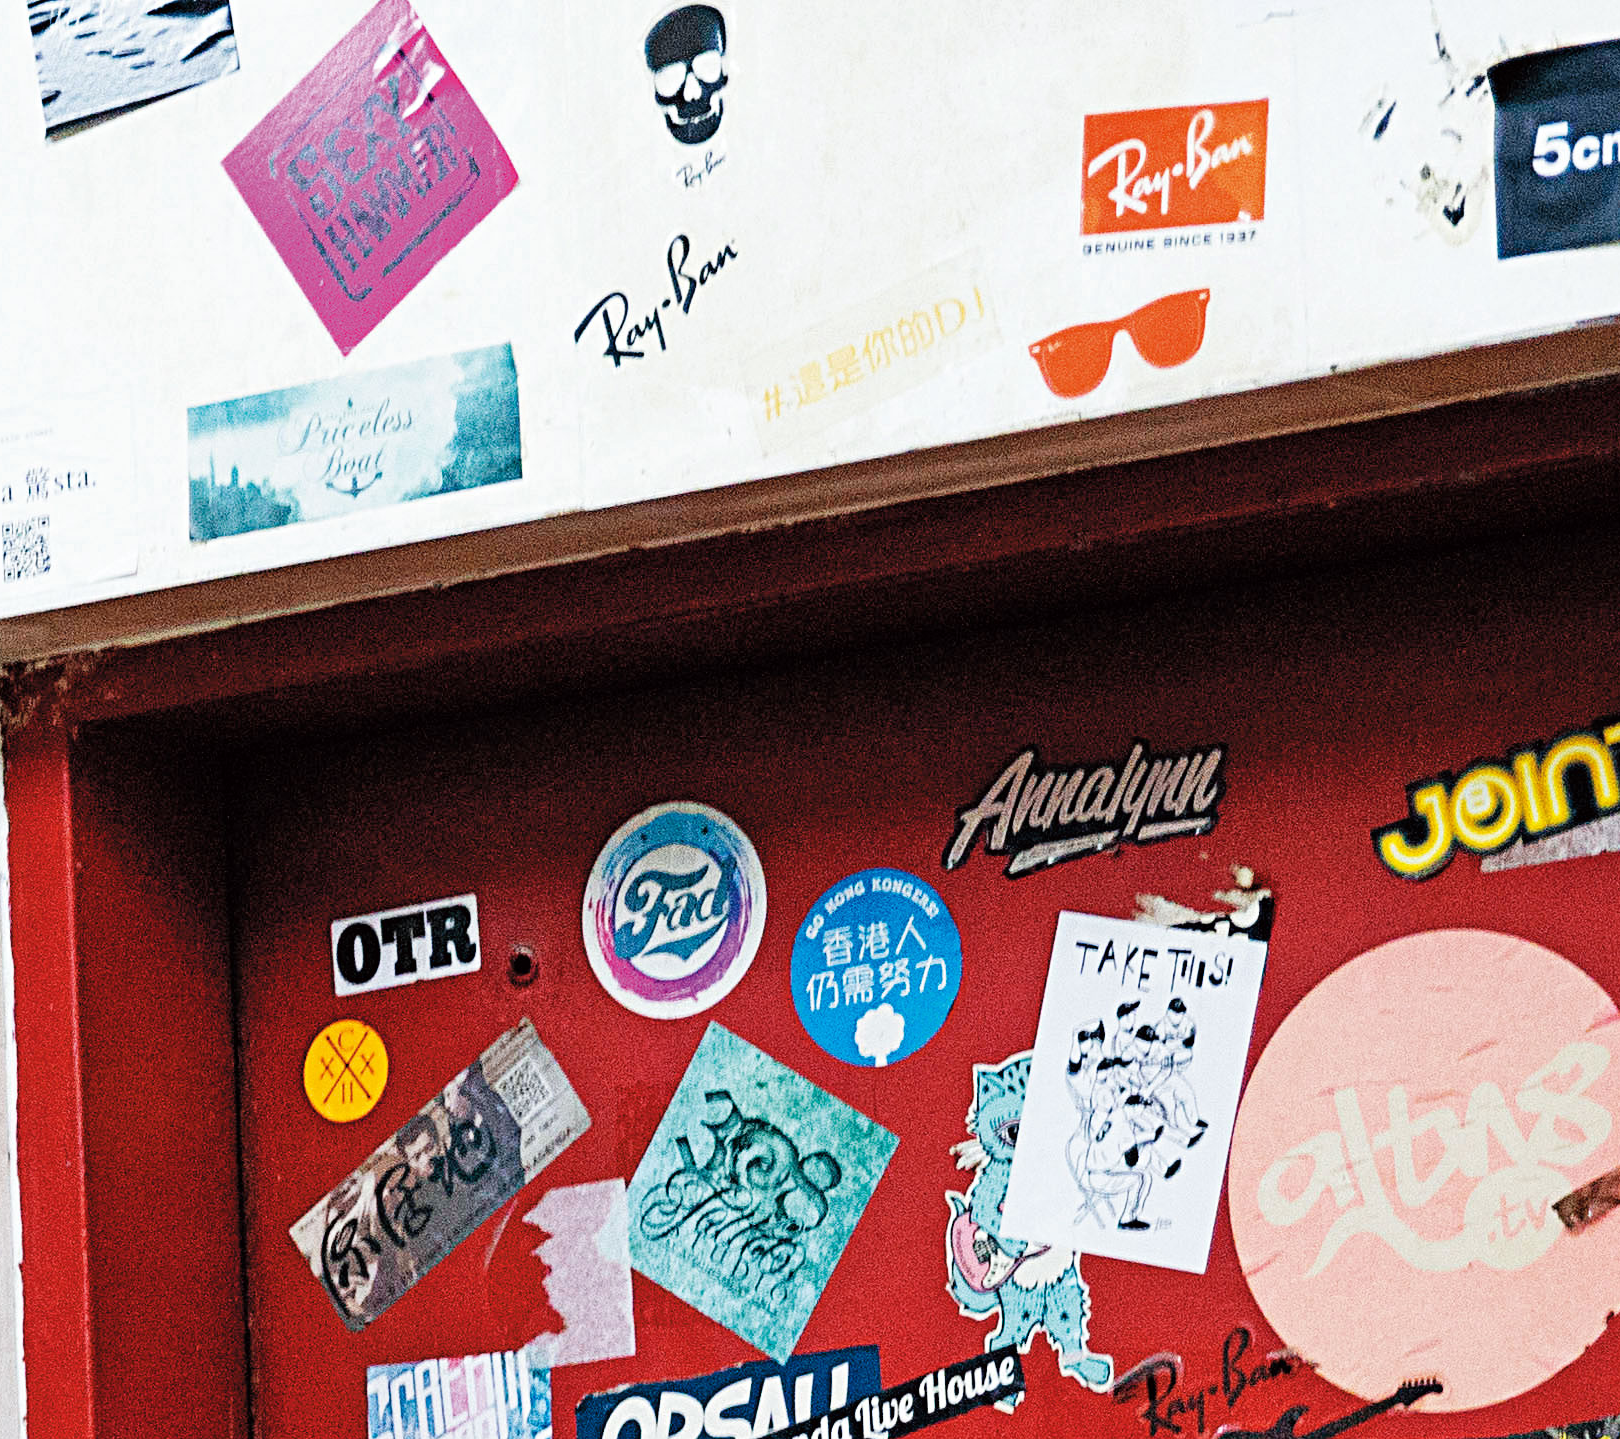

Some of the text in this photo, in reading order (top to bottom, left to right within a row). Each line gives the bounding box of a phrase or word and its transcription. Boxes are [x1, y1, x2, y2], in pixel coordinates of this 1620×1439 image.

[1088, 109, 1254, 217] Ray-Ban
[574, 234, 739, 368] Ray-Ban
[941, 742, 1226, 878] Annalynn
[334, 905, 477, 990] OTR
[805, 960, 950, 1014] 仍需努力
[821, 914, 929, 966] 香港人
[1076, 939, 1235, 991] TAKE THIS!
[1115, 1327, 1298, 1436] Ray-Ban
